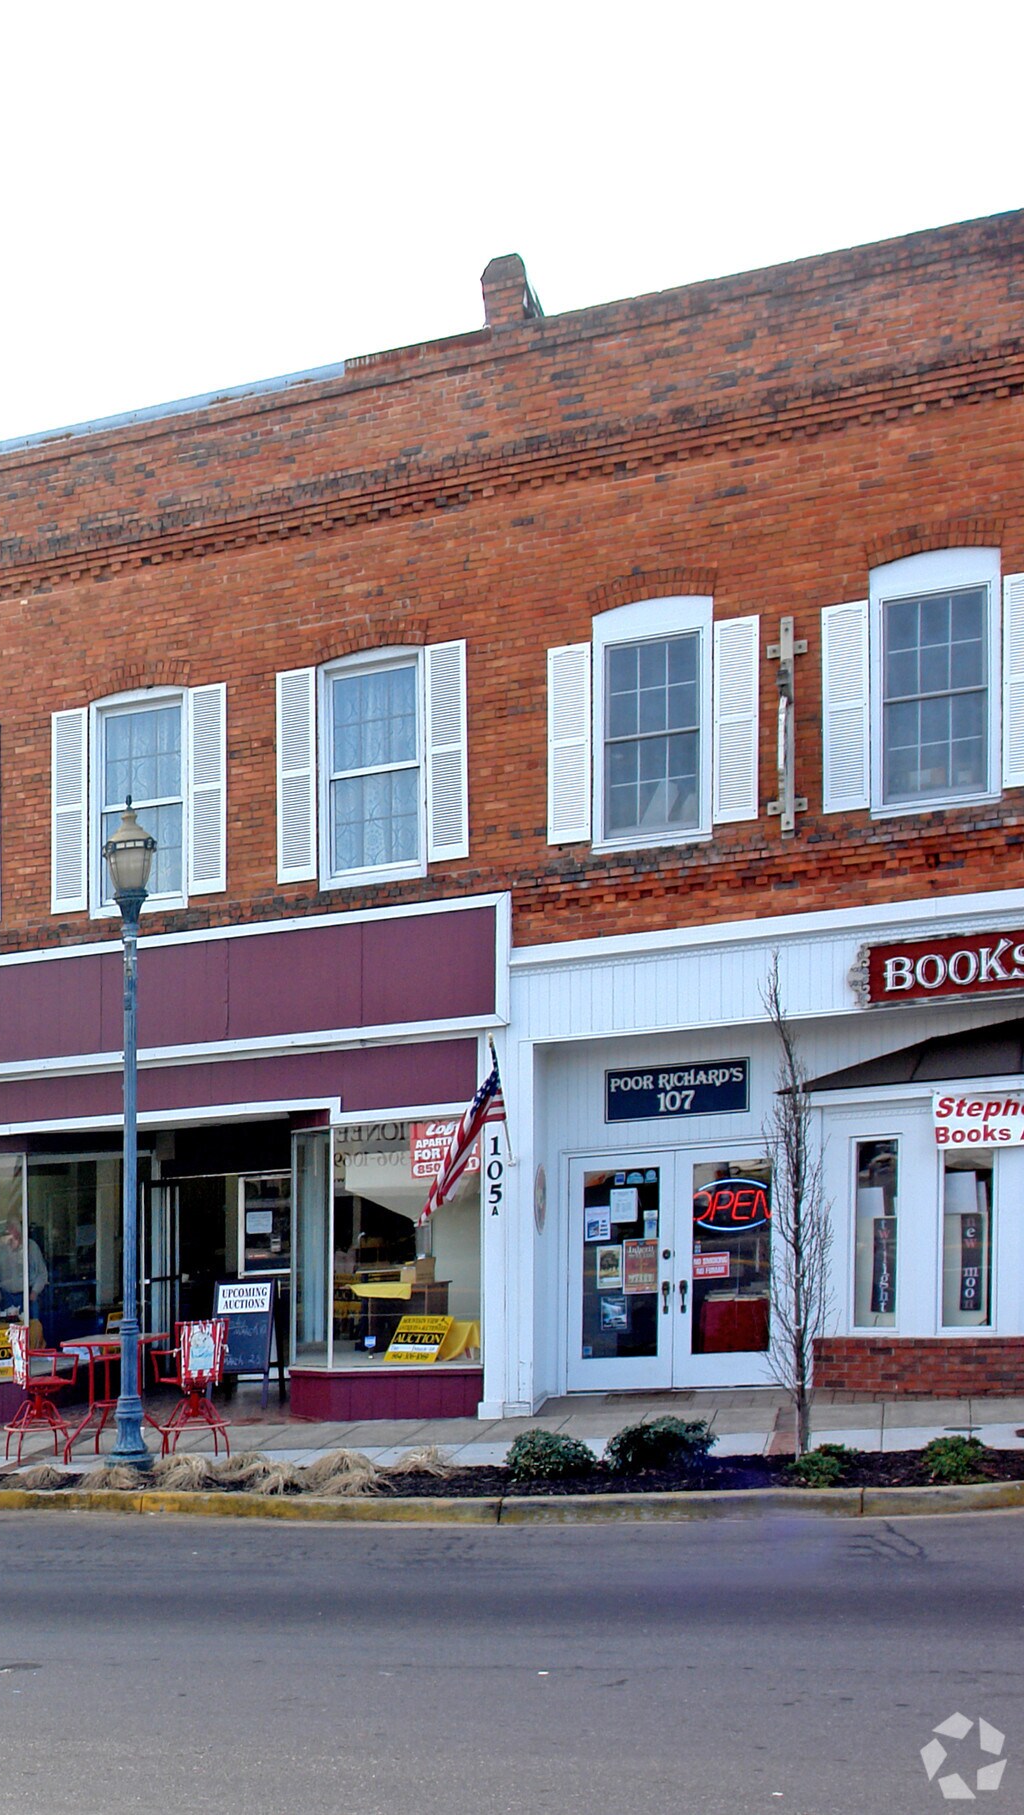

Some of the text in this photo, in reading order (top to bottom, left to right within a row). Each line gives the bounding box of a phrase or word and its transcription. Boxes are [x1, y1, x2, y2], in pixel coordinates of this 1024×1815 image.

[610, 1067, 744, 1092] POOR RICHARD'S
[657, 1090, 695, 1112] 107
[935, 1096, 1024, 1122] Steph
[935, 1124, 1012, 1144] Books
[414, 1148, 441, 1161] FOR
[693, 1189, 773, 1221] OPEN
[222, 1287, 268, 1299] UPCOMING
[223, 1298, 265, 1310] AUCTIONS
[393, 1333, 443, 1344] AUCTION
